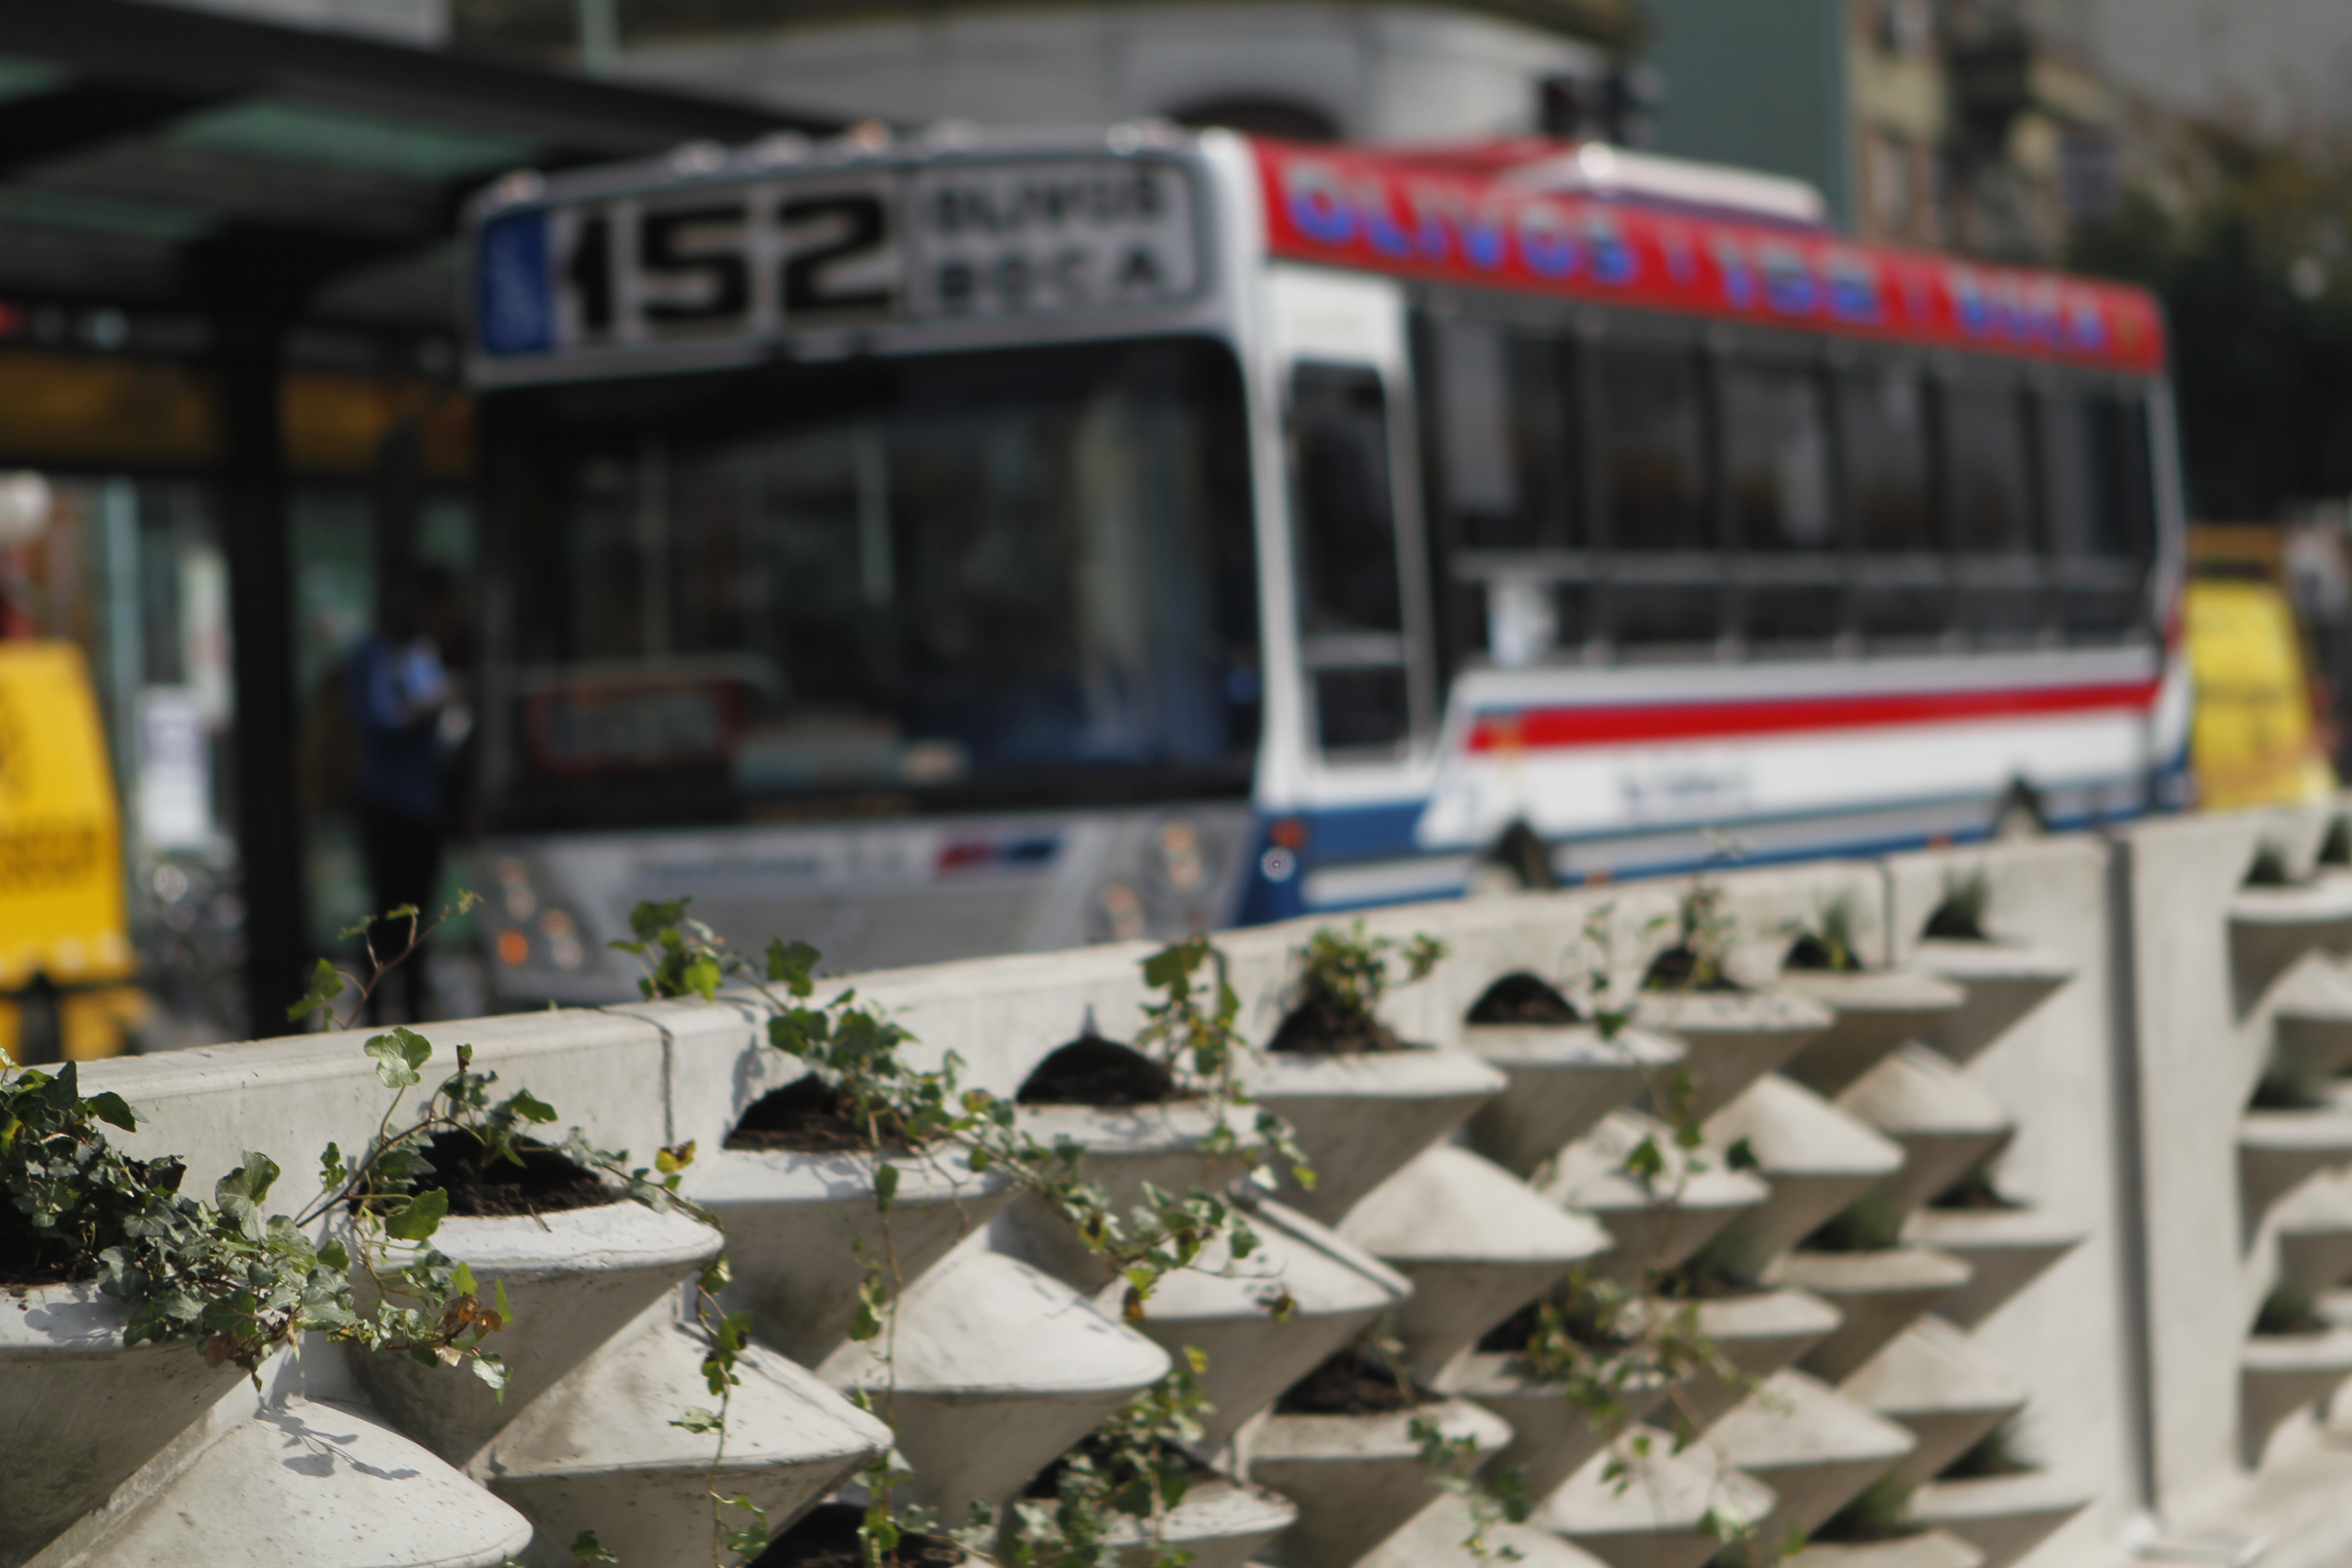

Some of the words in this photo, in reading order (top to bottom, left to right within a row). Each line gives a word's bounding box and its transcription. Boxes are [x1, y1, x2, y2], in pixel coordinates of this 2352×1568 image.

[568, 191, 894, 333] 152
[936, 246, 1165, 305] BOCA
[1279, 162, 1642, 286] OLIVOS
